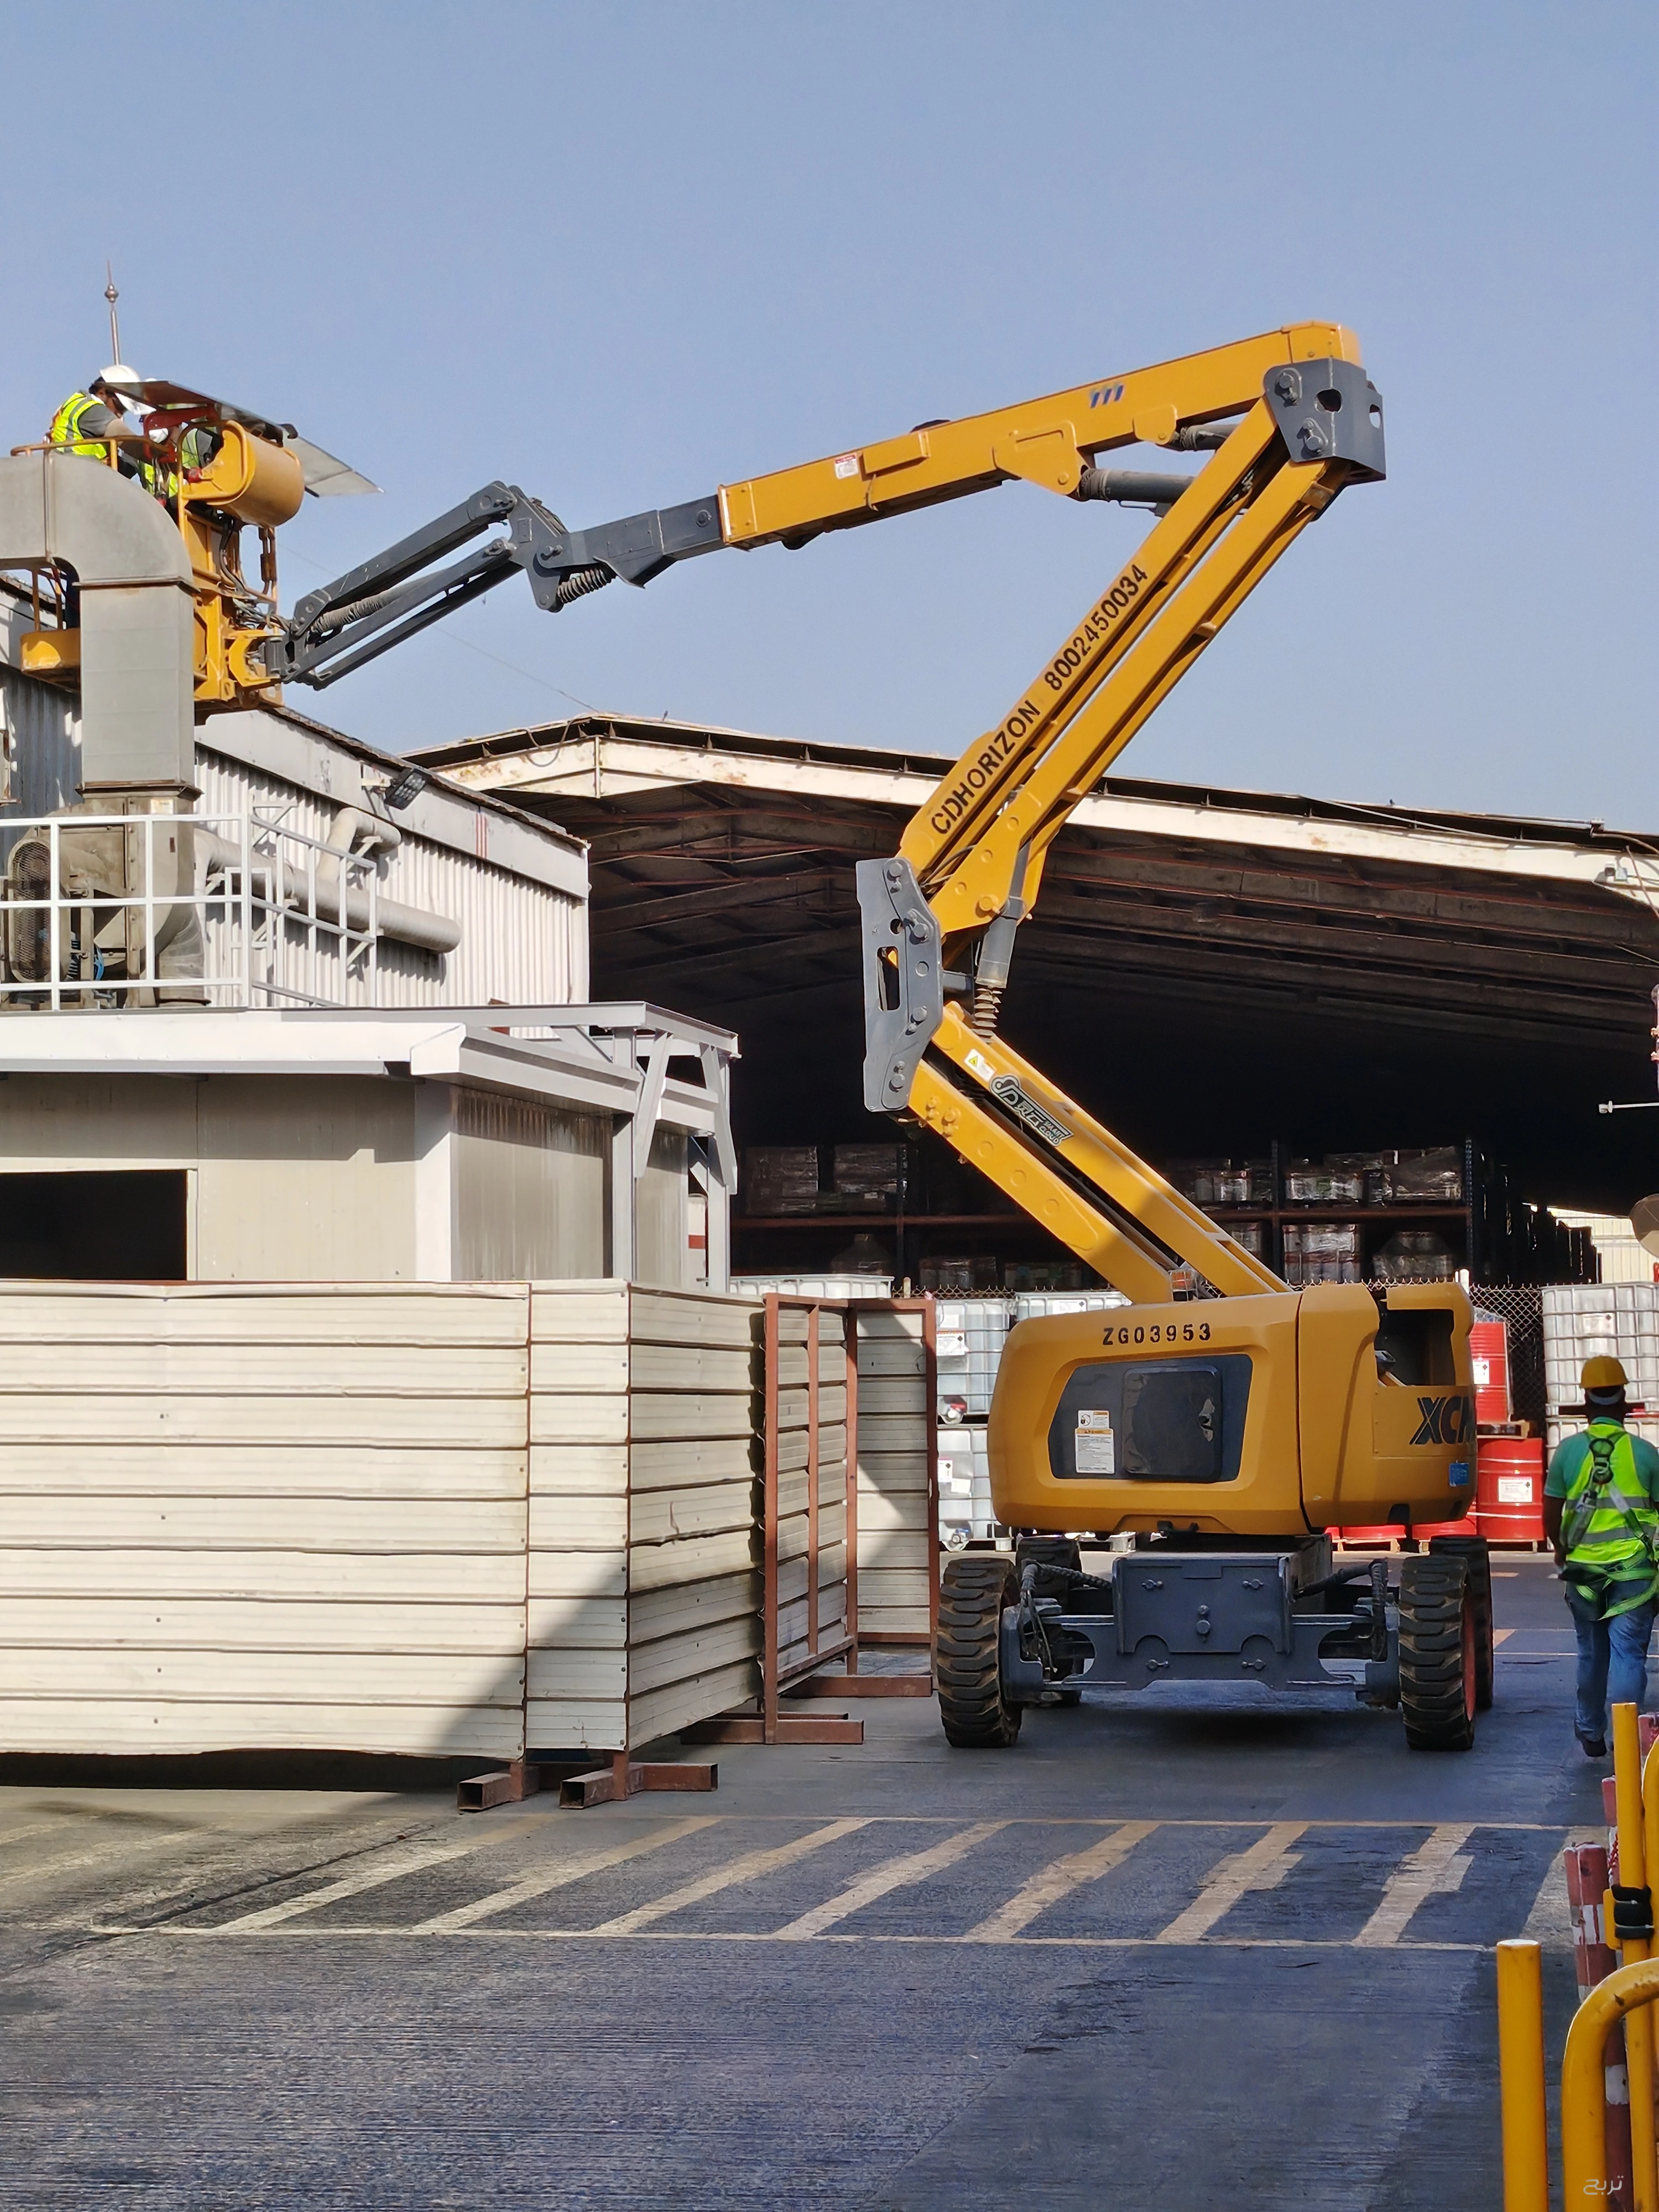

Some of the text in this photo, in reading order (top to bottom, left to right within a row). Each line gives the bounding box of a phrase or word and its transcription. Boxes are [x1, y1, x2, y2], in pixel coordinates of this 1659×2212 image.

[931, 564, 1147, 834] CDHORIZON 8002450034
[1102, 1323, 1211, 1345] ZG03953
